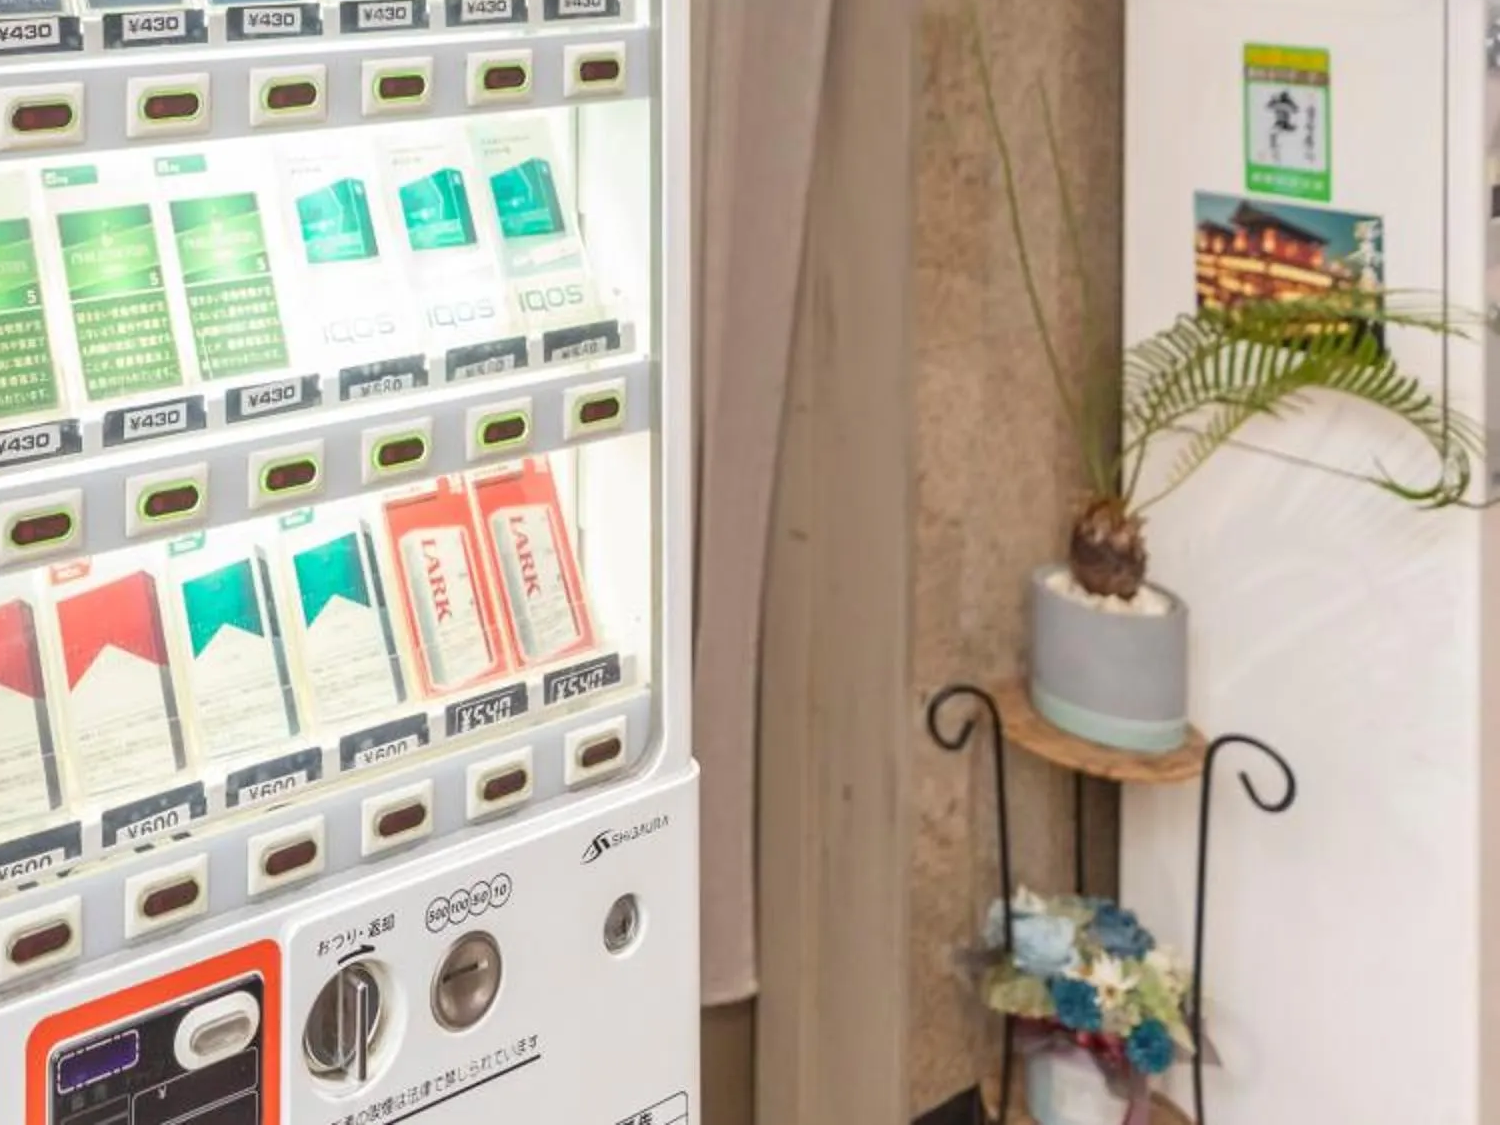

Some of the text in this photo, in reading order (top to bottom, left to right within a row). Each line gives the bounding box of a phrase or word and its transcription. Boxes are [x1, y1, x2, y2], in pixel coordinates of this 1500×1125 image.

[363, 6, 407, 22] ¥430
[467, 0, 507, 14] ¥430
[127, 15, 180, 33] ¥430
[249, 12, 295, 27] ¥430
[518, 284, 584, 314] IQOS
[426, 298, 496, 328] IQOS
[249, 385, 296, 408] ¥430
[130, 410, 180, 431] ¥430
[508, 516, 541, 597] LARK
[421, 538, 453, 623] LARK
